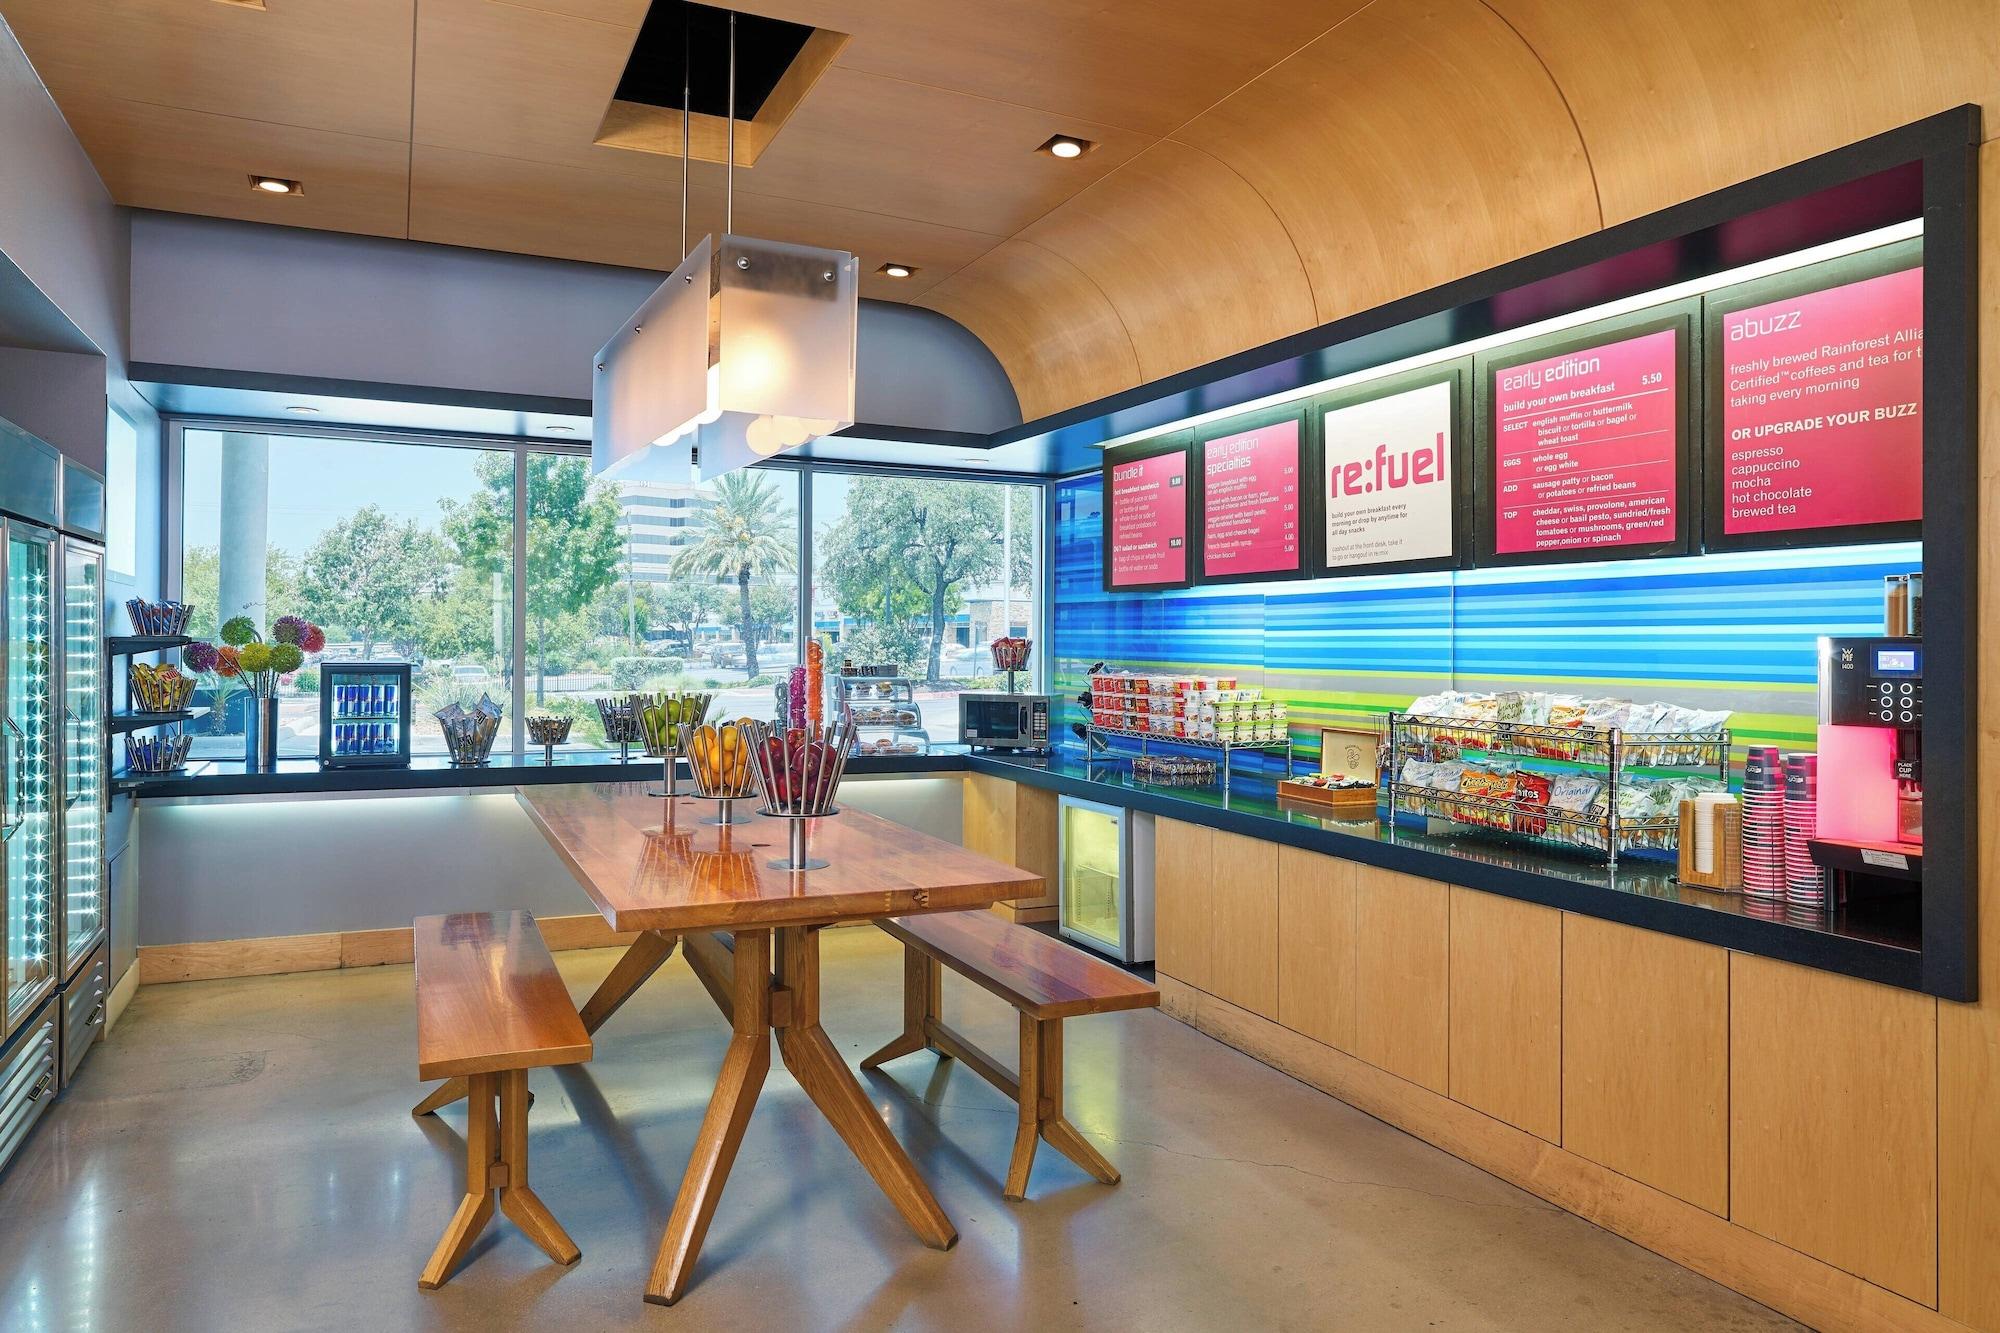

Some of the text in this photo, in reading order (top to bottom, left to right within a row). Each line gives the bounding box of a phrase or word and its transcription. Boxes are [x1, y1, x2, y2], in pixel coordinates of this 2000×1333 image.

[1731, 310, 1801, 342] abuzz
[1731, 328, 1923, 375] freshly brewed Rainforest Allia
[1791, 364, 1835, 381] coffees
[1840, 356, 1864, 372] and
[1869, 354, 1889, 367] tea
[1894, 349, 1912, 362] for
[1918, 345, 1922, 358] t
[1504, 357, 1600, 392] early edition
[1642, 372, 1662, 385] 5.50
[1504, 381, 1615, 413] build your own breakfast
[1731, 378, 1860, 408] taking every morning
[1533, 416, 1557, 427] english
[1560, 412, 1582, 422] muffin
[1593, 402, 1632, 416] buttermilk
[1732, 402, 1917, 441] OR UPGRADE YOUR BUZZ
[1504, 421, 1528, 432] SELECT
[1538, 426, 1561, 436] biscuit
[1572, 421, 1595, 430] tortilla
[1607, 414, 1627, 425] bagel
[1538, 433, 1578, 446] wheat toast
[1208, 438, 1259, 459] early edition
[1732, 446, 1783, 462] espresso
[1207, 456, 1251, 476] specialties
[1331, 432, 1444, 498] re:fuel
[1504, 458, 1521, 467] EGGS
[1533, 454, 1553, 463] whole
[1559, 461, 1578, 469] white
[1114, 466, 1138, 482] bundle
[1732, 459, 1800, 476] cappuccino
[1533, 481, 1560, 489] sausage
[1562, 477, 1580, 487] patty
[1591, 474, 1613, 482] bacon
[1732, 476, 1771, 489] mocha
[1546, 489, 1576, 500] potatoes
[1587, 484, 1611, 493] refried
[1613, 482, 1636, 490] beans
[1732, 486, 1812, 504] hot chocolate
[1368, 505, 1391, 514] breakfast
[1533, 508, 1562, 516] cheddar,
[1587, 502, 1627, 513] provolone,
[1629, 497, 1665, 506] american
[1589, 513, 1611, 523] pesto,
[1614, 506, 1671, 519] sundried/fresh
[1732, 504, 1796, 518] brewed tea
[1378, 514, 1398, 522] anytime
[1579, 524, 1624, 532] mushrooms,
[1626, 518, 1664, 530] green/red
[1593, 533, 1621, 543] spinach
[1554, 785, 1592, 799] Original
